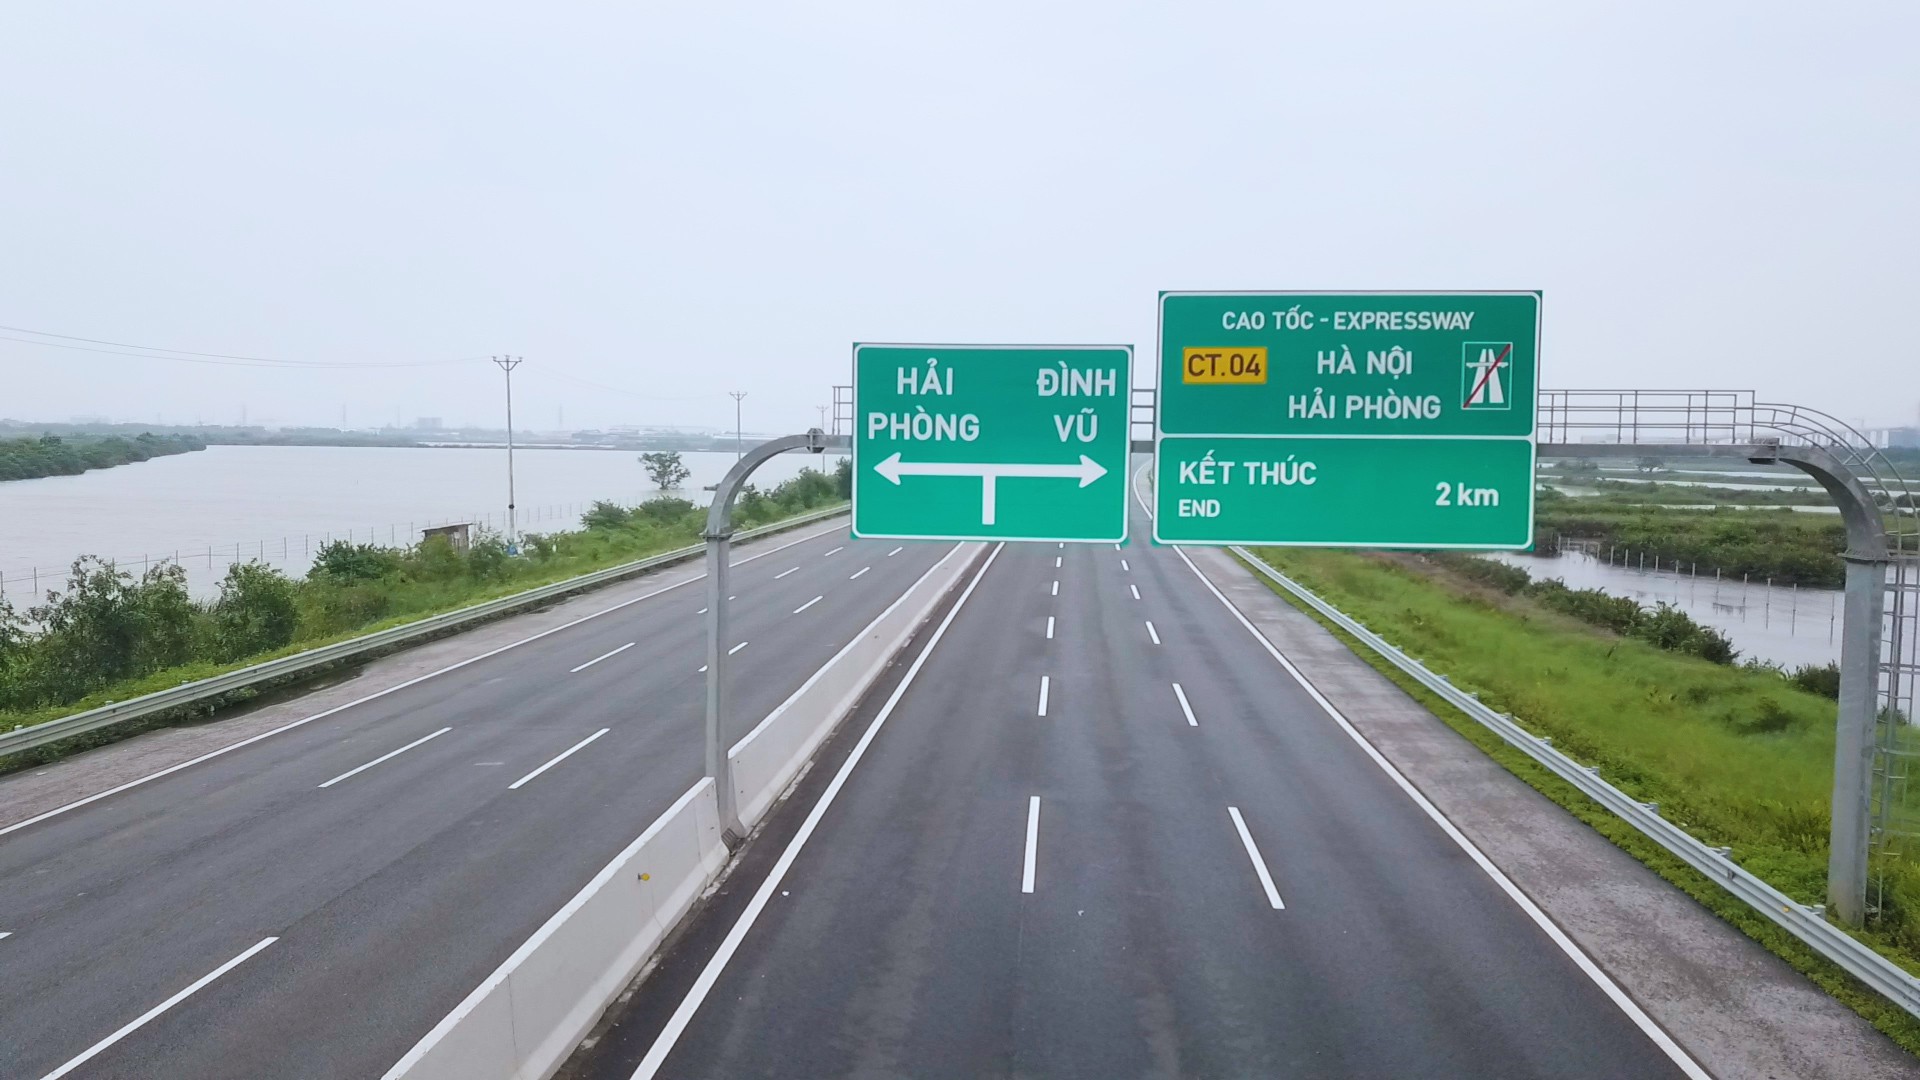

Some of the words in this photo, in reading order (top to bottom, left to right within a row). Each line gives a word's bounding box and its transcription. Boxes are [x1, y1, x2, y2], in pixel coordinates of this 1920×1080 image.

[1222, 311, 1265, 330] CAO
[1272, 305, 1314, 330] TỐC
[1334, 311, 1475, 331] EXPRESSWAY
[897, 357, 953, 396] HẢI
[1037, 361, 1116, 397] ĐÌNH
[1187, 354, 1261, 377] CT.04
[1317, 345, 1357, 374] HÀ
[1367, 346, 1412, 379] NỘI
[1288, 387, 1335, 419] HẢI
[1345, 389, 1441, 419] PHÒNG
[868, 406, 980, 442] PHÒNG
[1054, 408, 1098, 442] VŨ
[1179, 450, 1235, 484] KẾT
[1244, 455, 1317, 485] THÚC
[1178, 499, 1220, 517] END
[1435, 482, 1451, 506] 2
[1457, 482, 1499, 506] km
